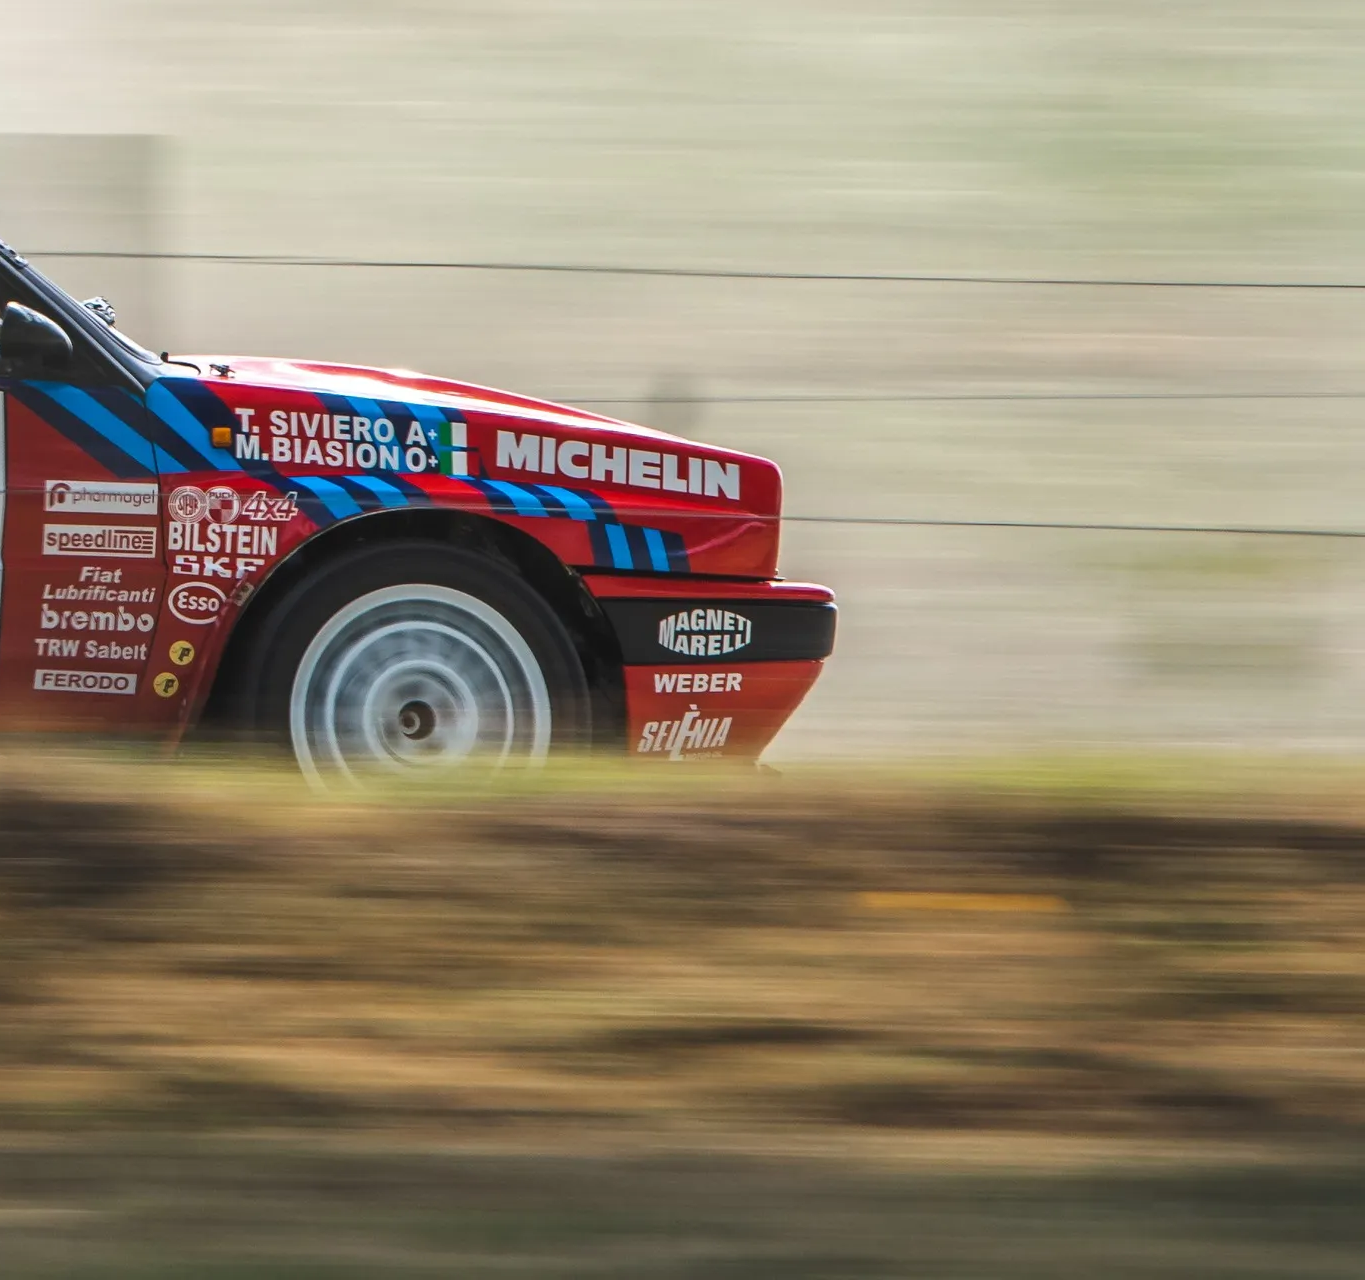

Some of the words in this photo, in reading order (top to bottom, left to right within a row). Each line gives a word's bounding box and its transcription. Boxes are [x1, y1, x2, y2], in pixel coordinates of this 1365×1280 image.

[235, 407, 260, 434] T.
[269, 410, 395, 443] SIVIERO
[496, 430, 741, 501] MICHELIN
[209, 491, 234, 499] PUCH
[45, 528, 153, 555] speedline
[168, 521, 277, 556] BILSTEIN
[79, 566, 122, 584] Fiat
[173, 555, 265, 580] SKF
[42, 584, 156, 604] Lubrificanti
[177, 591, 220, 613] Esso
[40, 603, 155, 633] brembo
[658, 608, 751, 640] MAGNETI
[35, 638, 80, 658] TRW
[41, 672, 130, 692] FERODO
[654, 672, 743, 693] WEBER
